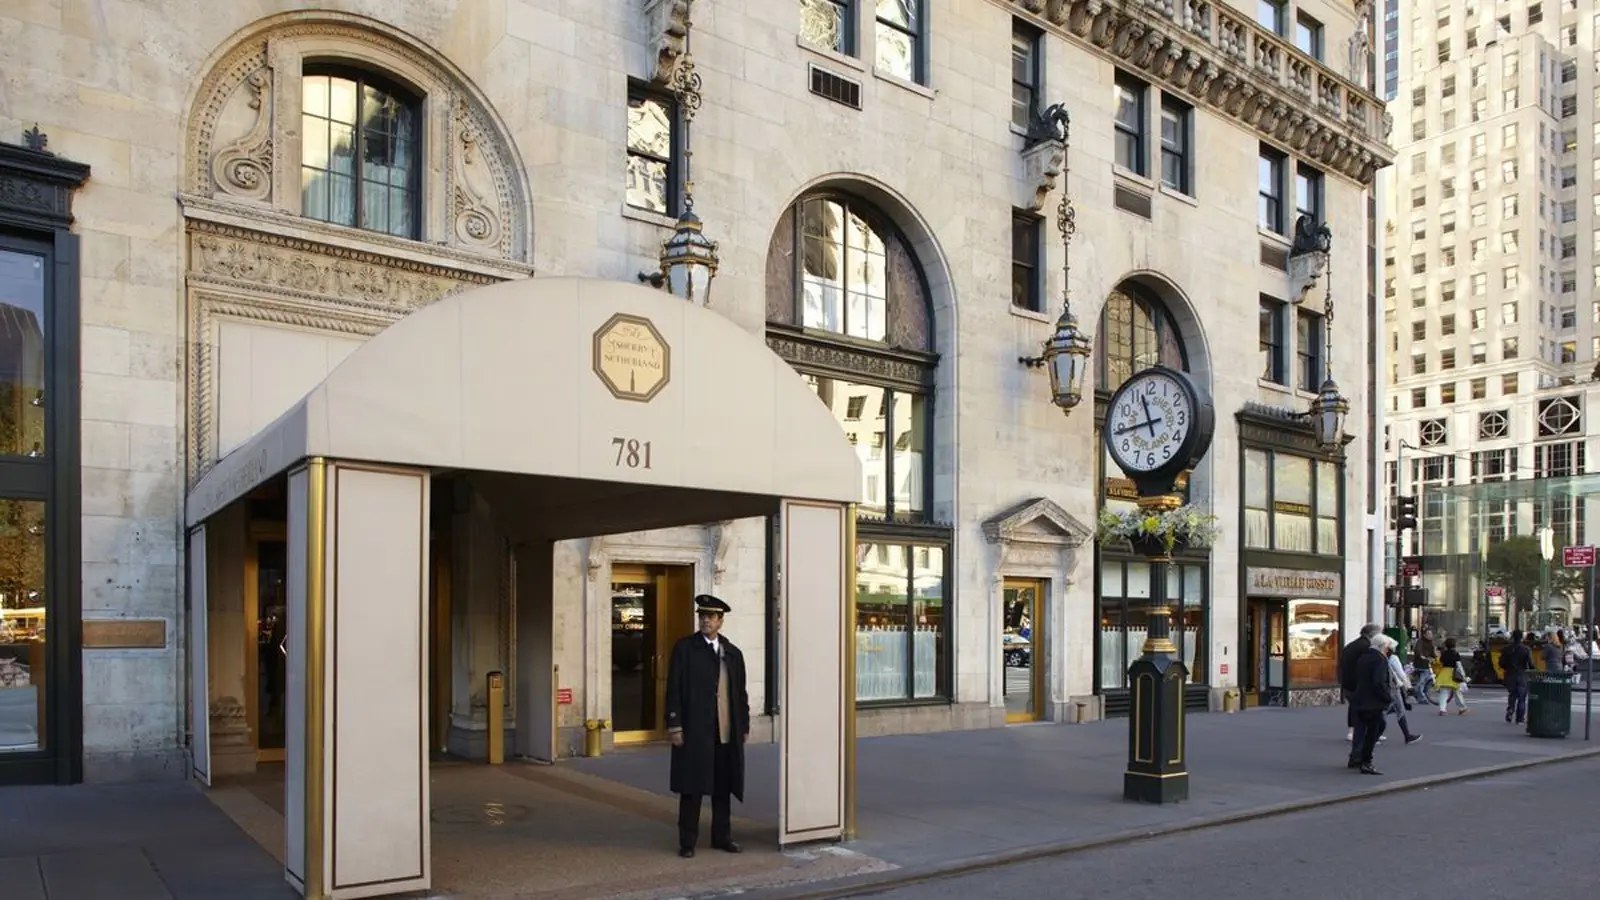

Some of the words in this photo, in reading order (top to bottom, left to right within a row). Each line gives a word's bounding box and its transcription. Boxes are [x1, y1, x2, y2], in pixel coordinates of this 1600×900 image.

[1145, 381, 1156, 395] 12
[1163, 383, 1167, 396] 1
[1130, 388, 1140, 403] 11
[1173, 392, 1181, 407] 2
[1120, 404, 1131, 417] 10
[1177, 411, 1185, 425] 3
[1117, 422, 1126, 435] 9
[1172, 429, 1182, 443] 4
[1122, 439, 1130, 452] 8
[1162, 445, 1171, 459] 5
[612, 437, 651, 469] 781
[1133, 450, 1140, 464] 7
[1147, 452, 1155, 466] 6
